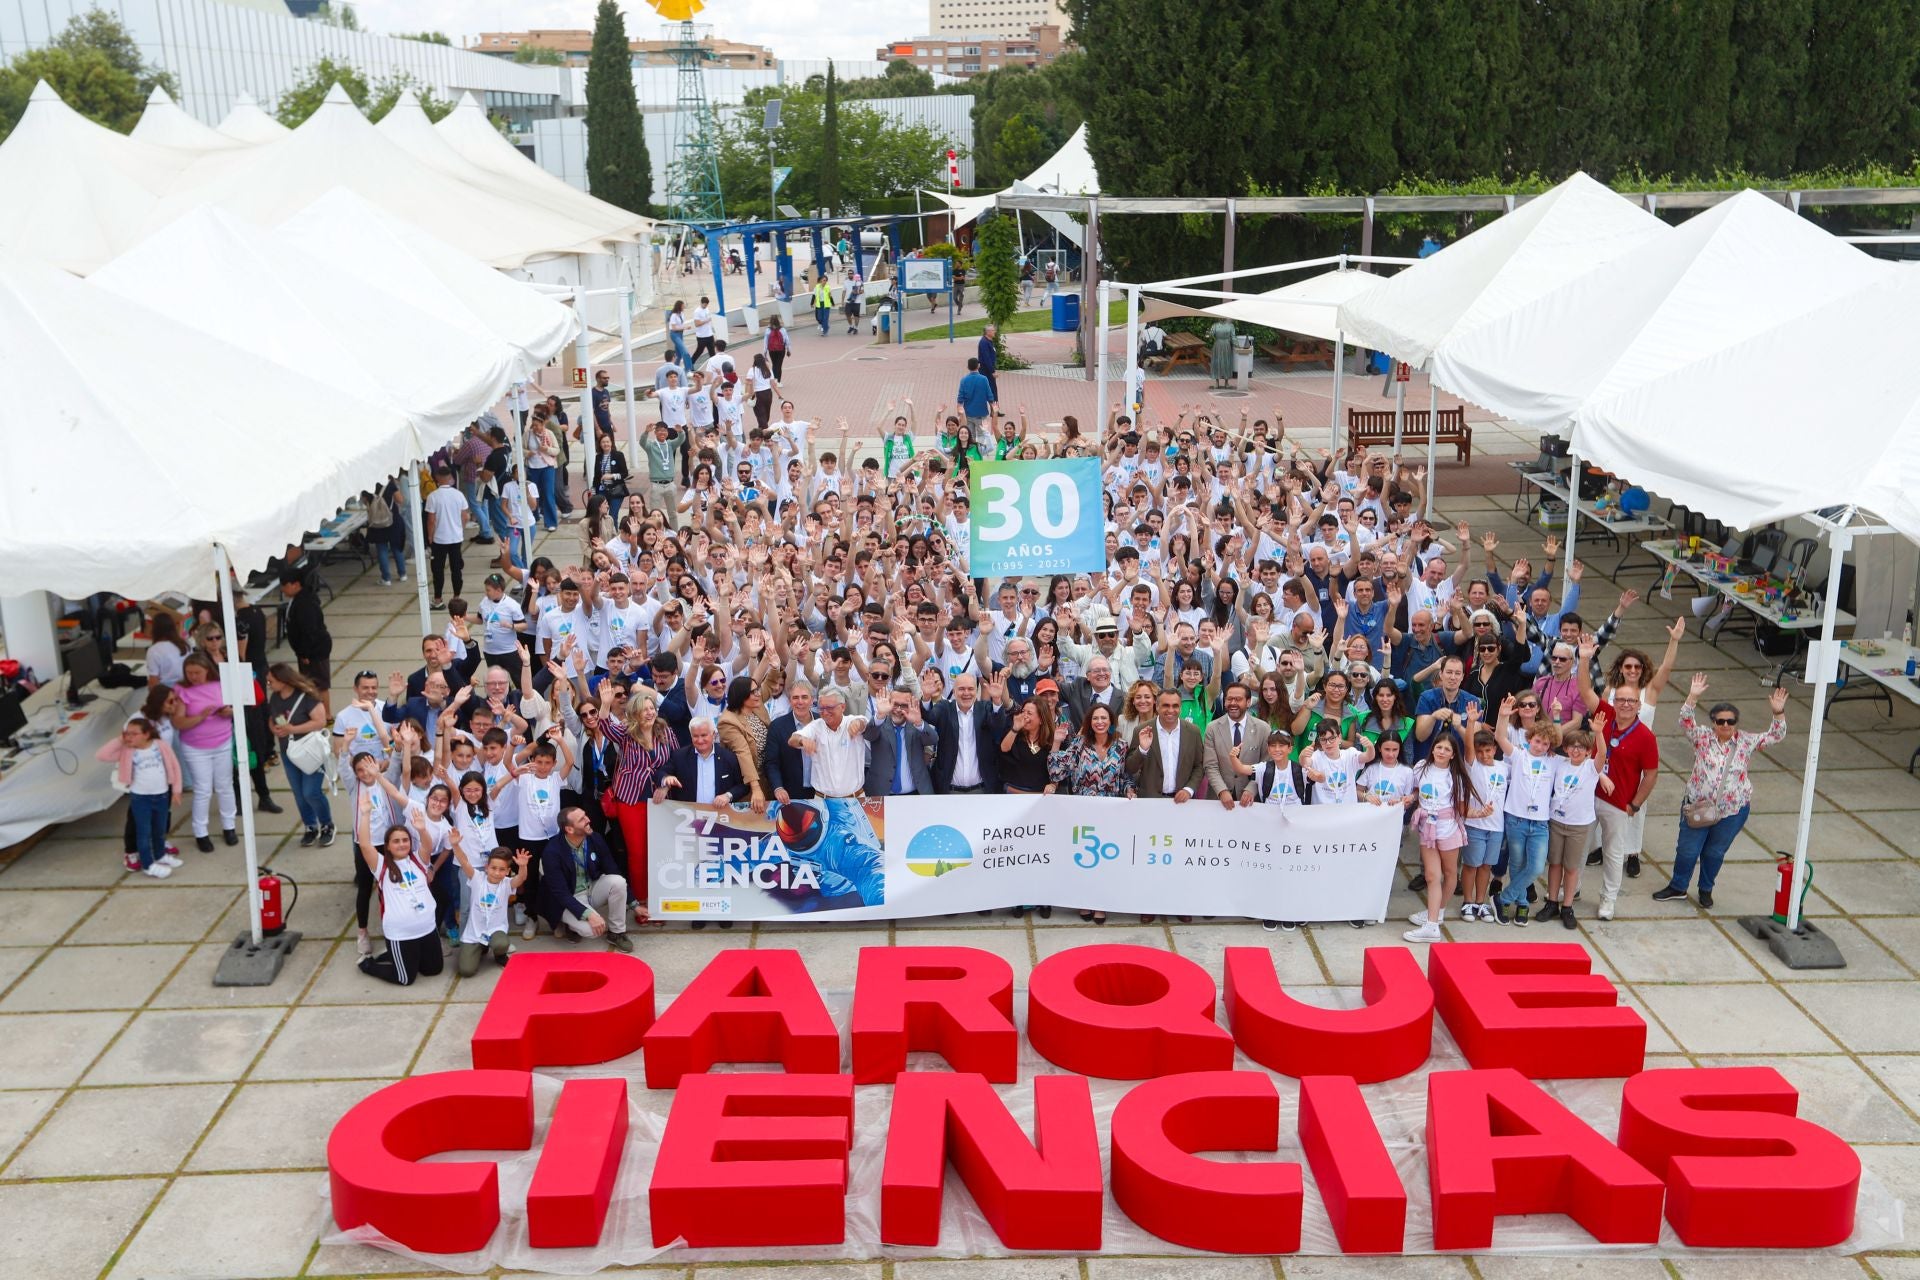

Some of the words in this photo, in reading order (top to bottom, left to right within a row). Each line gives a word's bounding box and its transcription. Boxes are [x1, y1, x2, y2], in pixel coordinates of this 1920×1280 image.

[978, 471, 1080, 541] 30
[1007, 543, 1053, 557] AÑOS
[991, 561, 1023, 572] (1995
[1039, 558, 1071, 569] 2025)
[982, 824, 1046, 840] PARQUE
[673, 835, 791, 862] FERIA
[983, 844, 997, 855] de
[999, 844, 1014, 853] las
[1148, 834, 1174, 847] 15
[1185, 838, 1272, 854] MILLONES
[1282, 844, 1303, 855] DE
[1313, 841, 1378, 854] VISITAS
[982, 853, 1051, 869] CIENCIAS
[1146, 853, 1173, 866] 30
[1184, 855, 1231, 867] AÑOS
[1240, 861, 1273, 872] (1995
[1289, 864, 1322, 872] 2025)
[657, 862, 820, 890] CIENCIA
[472, 943, 1647, 1089] PARQUE
[327, 1066, 1862, 1254] CIENCIAS
